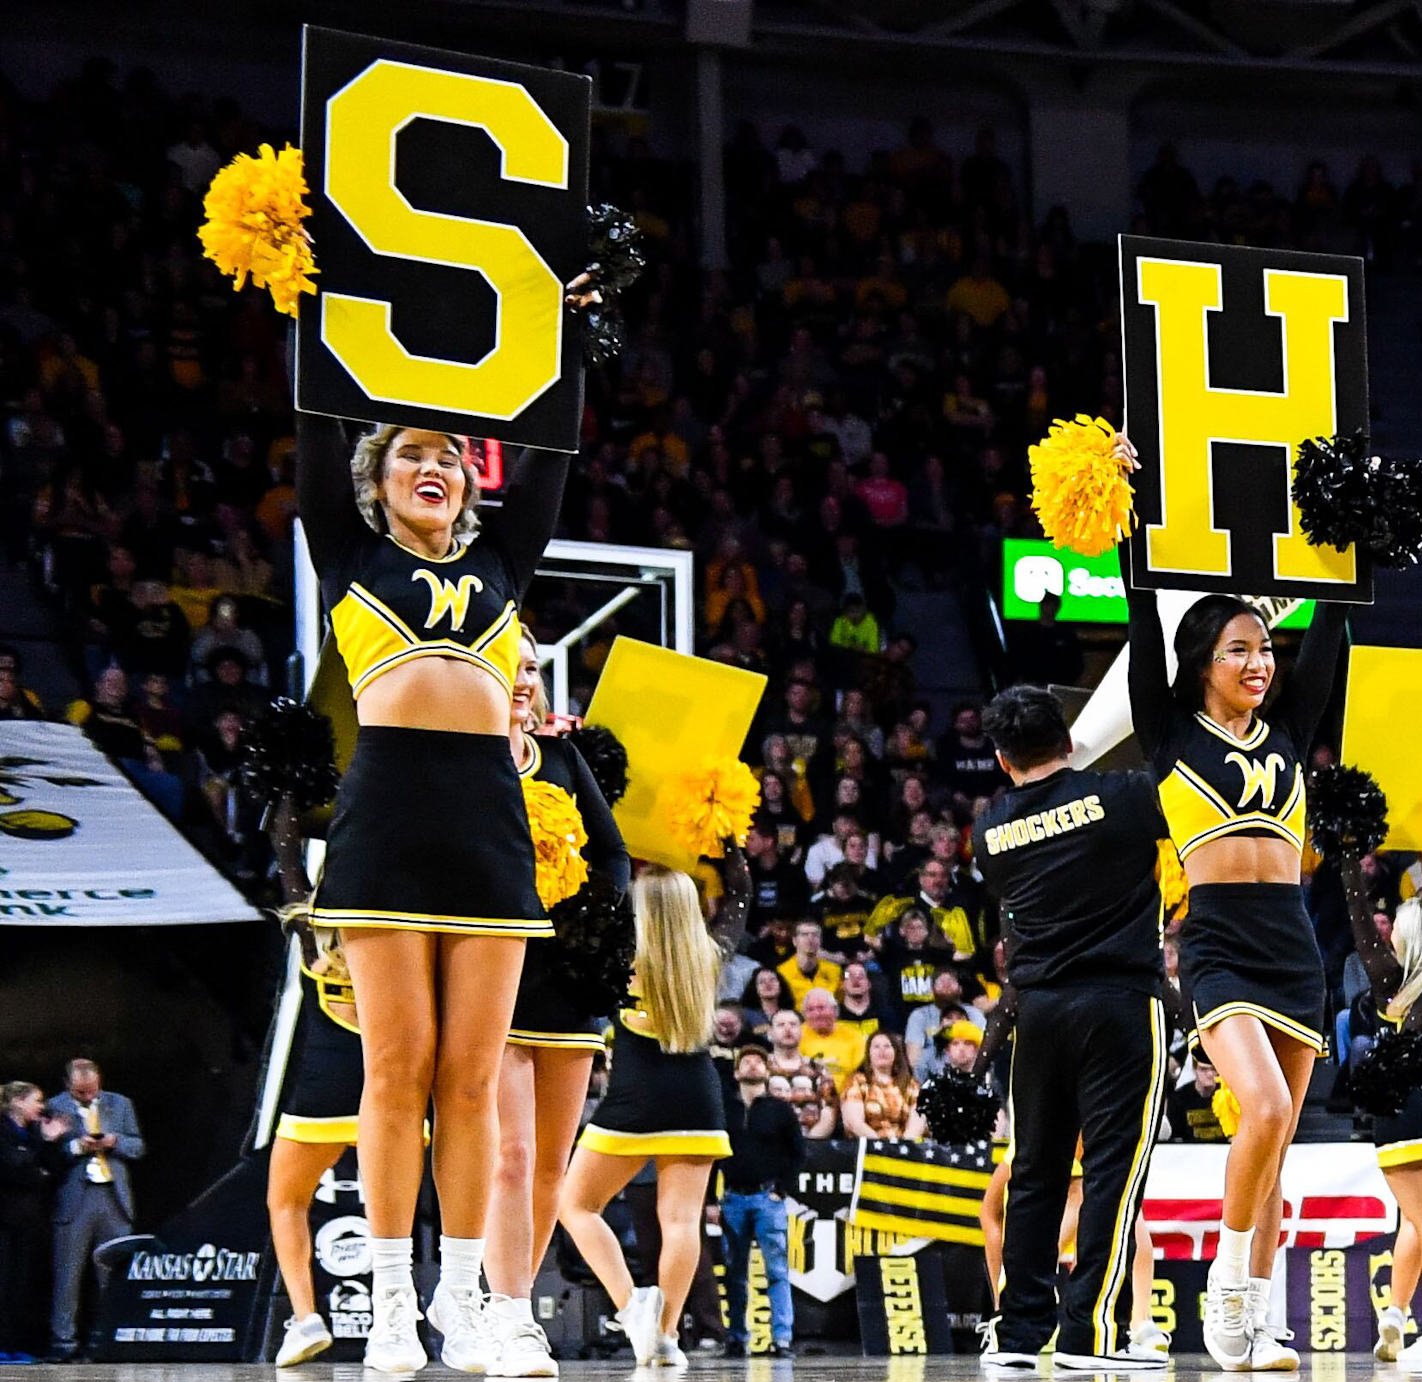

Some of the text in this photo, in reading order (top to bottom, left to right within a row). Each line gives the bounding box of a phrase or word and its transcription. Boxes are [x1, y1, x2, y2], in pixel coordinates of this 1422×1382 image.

[321, 58, 570, 422] S
[1136, 256, 1358, 585] H
[411, 569, 484, 633] W
[985, 794, 1106, 856] SHOCKERS
[798, 1172, 854, 1194] THE
[127, 1248, 261, 1281] KANSAS STAR
[329, 1311, 374, 1327] TACO
[880, 1257, 927, 1354] DEFENSE
[1310, 1250, 1347, 1351] SHOCKS
